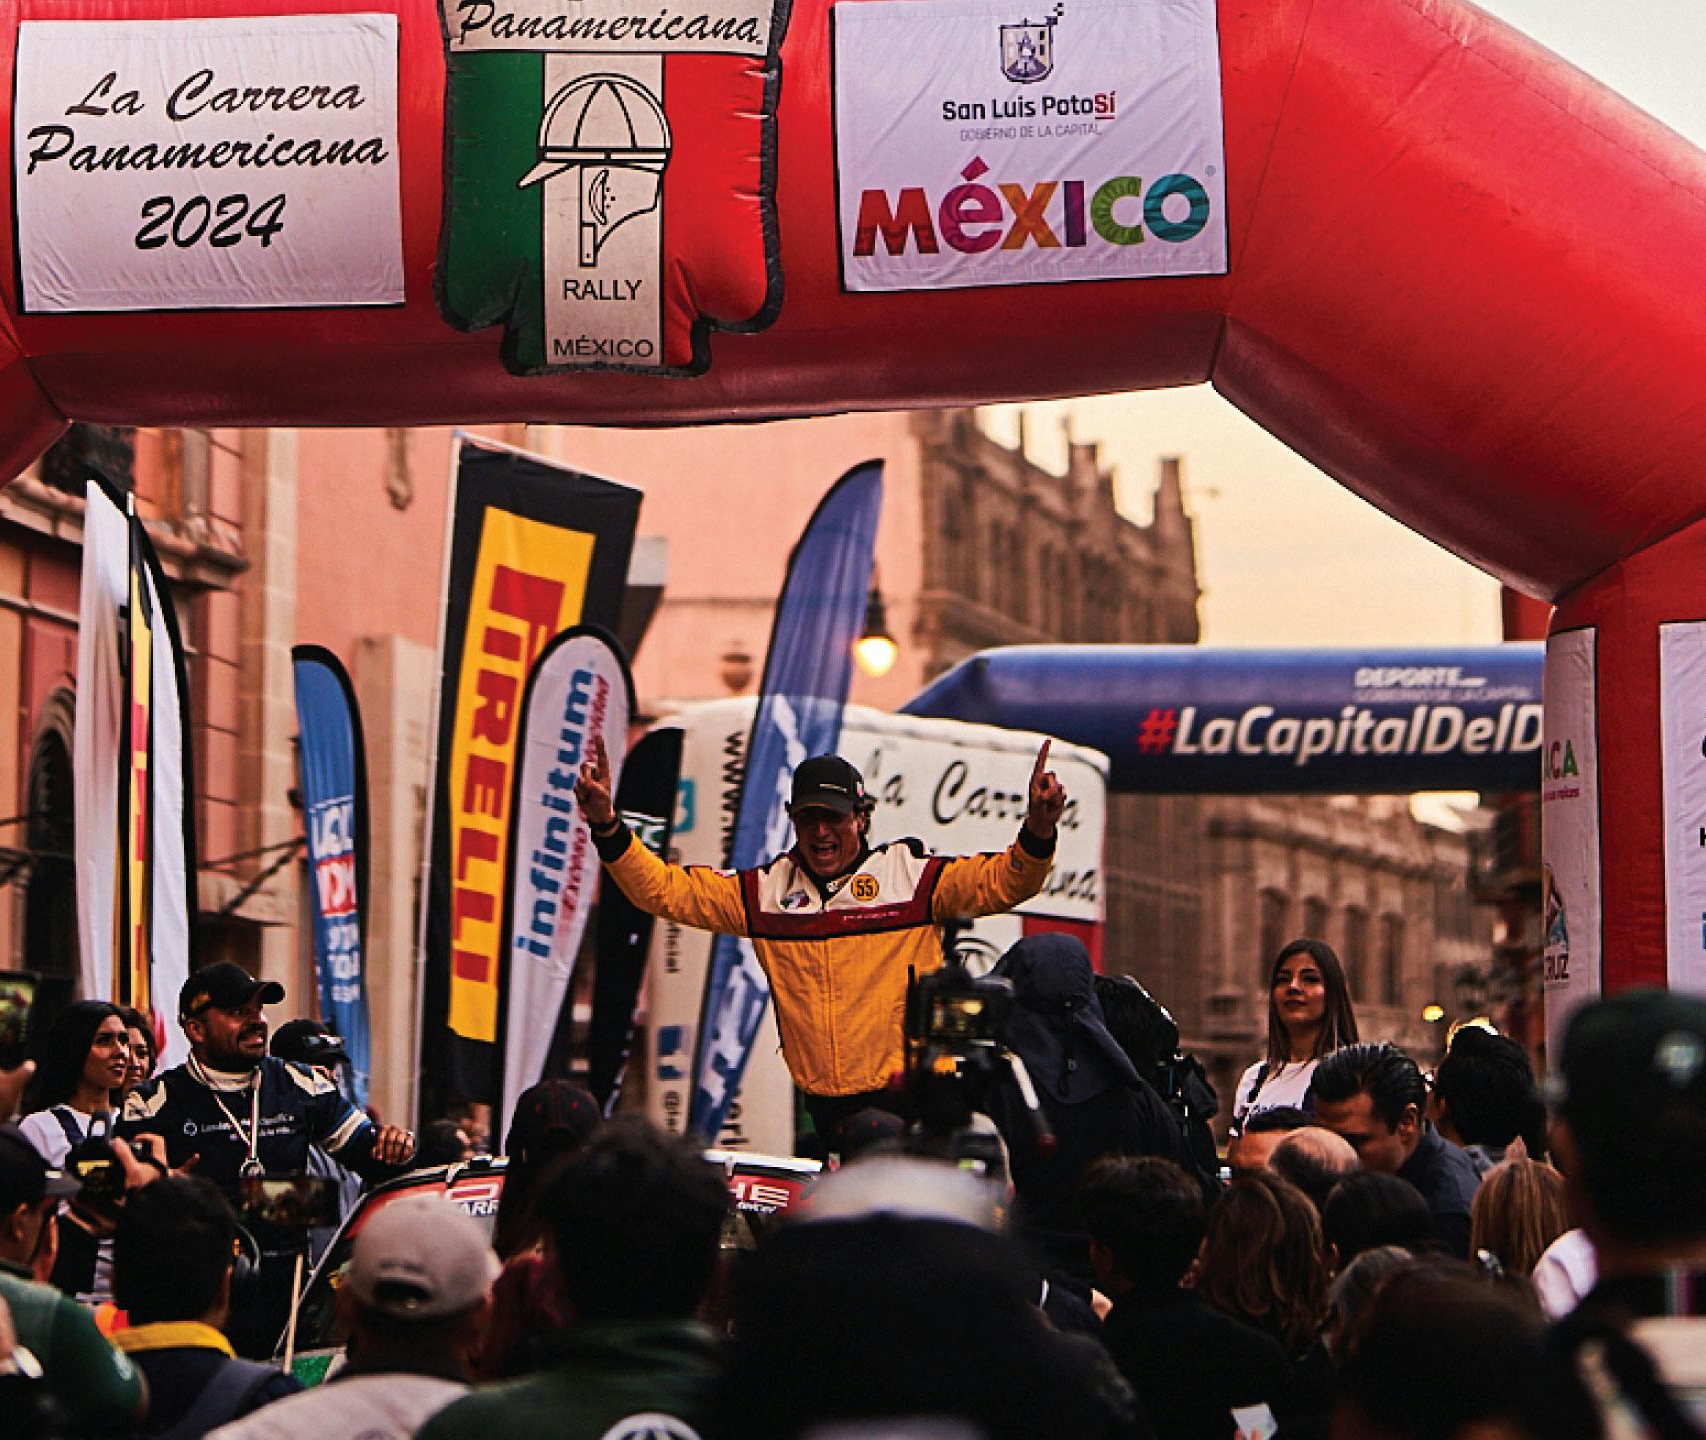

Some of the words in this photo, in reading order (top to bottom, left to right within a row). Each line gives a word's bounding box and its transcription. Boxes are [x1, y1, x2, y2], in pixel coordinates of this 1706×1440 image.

[64, 70, 145, 116] La
[165, 68, 366, 121] Carrera
[942, 99, 986, 121] San
[991, 95, 1037, 119] Luis
[26, 124, 389, 175] Panamericana
[960, 126, 1017, 143] GOBIERNO
[1019, 124, 1034, 139] DE
[1037, 123, 1054, 138] LA
[1055, 122, 1103, 138] CAPITAL
[134, 193, 287, 251] 2024
[563, 278, 643, 301] RALLY
[552, 334, 654, 357] MÉXICO
[453, 564, 566, 984] PIRELLI
[514, 667, 593, 959] infinitum
[856, 878, 874, 897] 55
